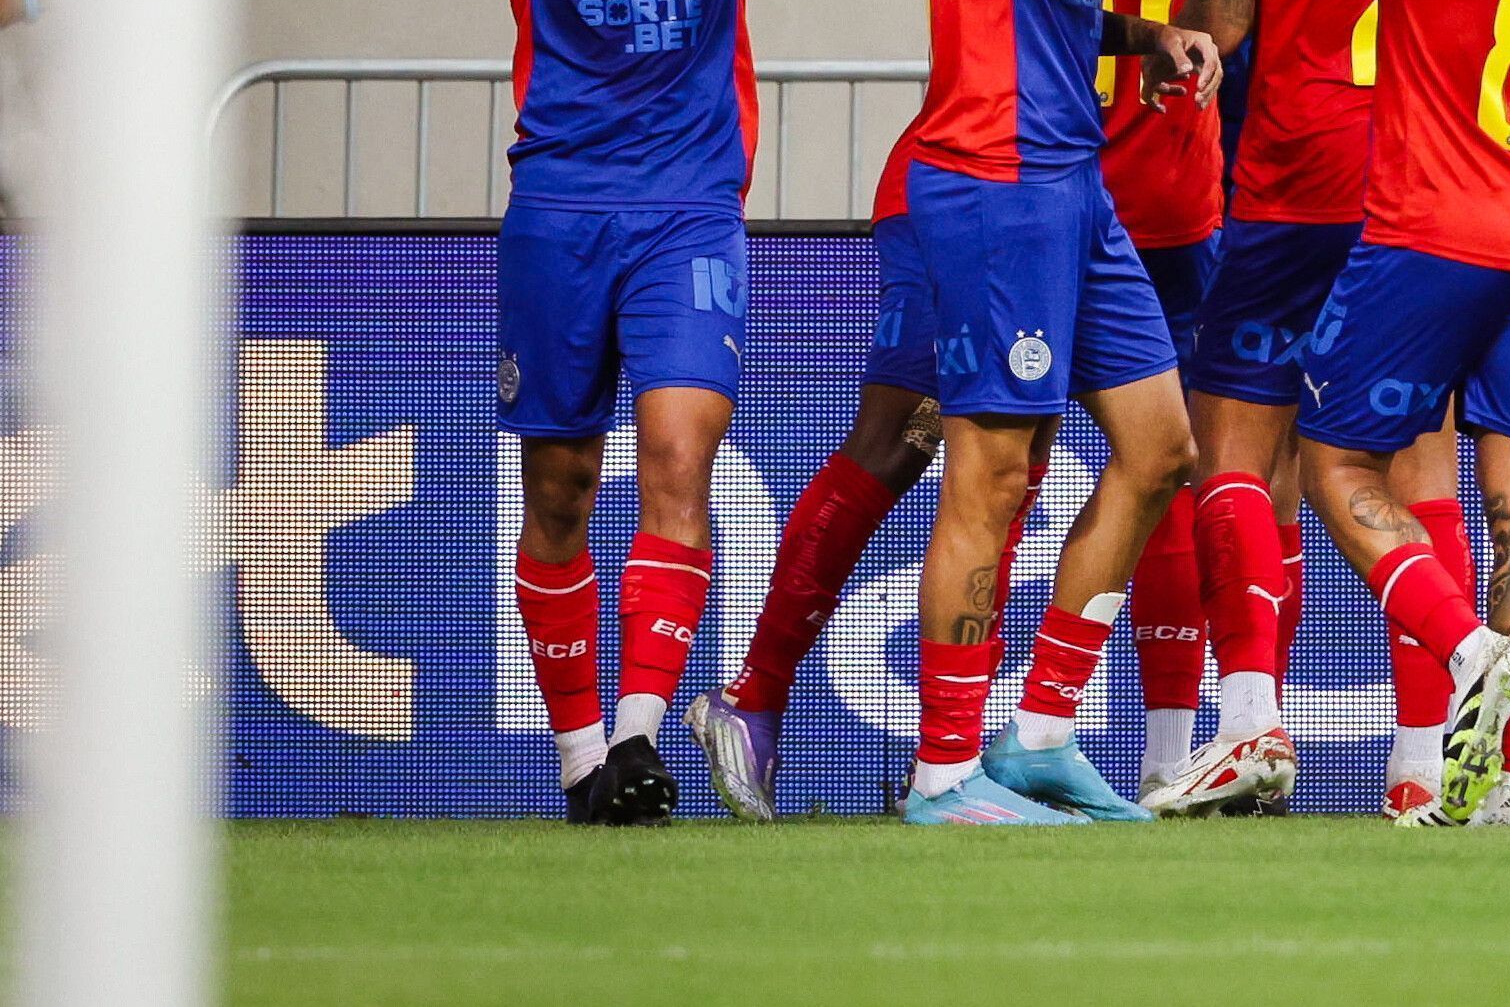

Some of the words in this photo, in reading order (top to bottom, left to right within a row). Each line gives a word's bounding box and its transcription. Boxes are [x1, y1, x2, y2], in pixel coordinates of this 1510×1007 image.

[934, 322, 979, 376] xi
[650, 618, 693, 647] EC
[1135, 625, 1200, 642] ECB
[531, 638, 588, 659] ECB
